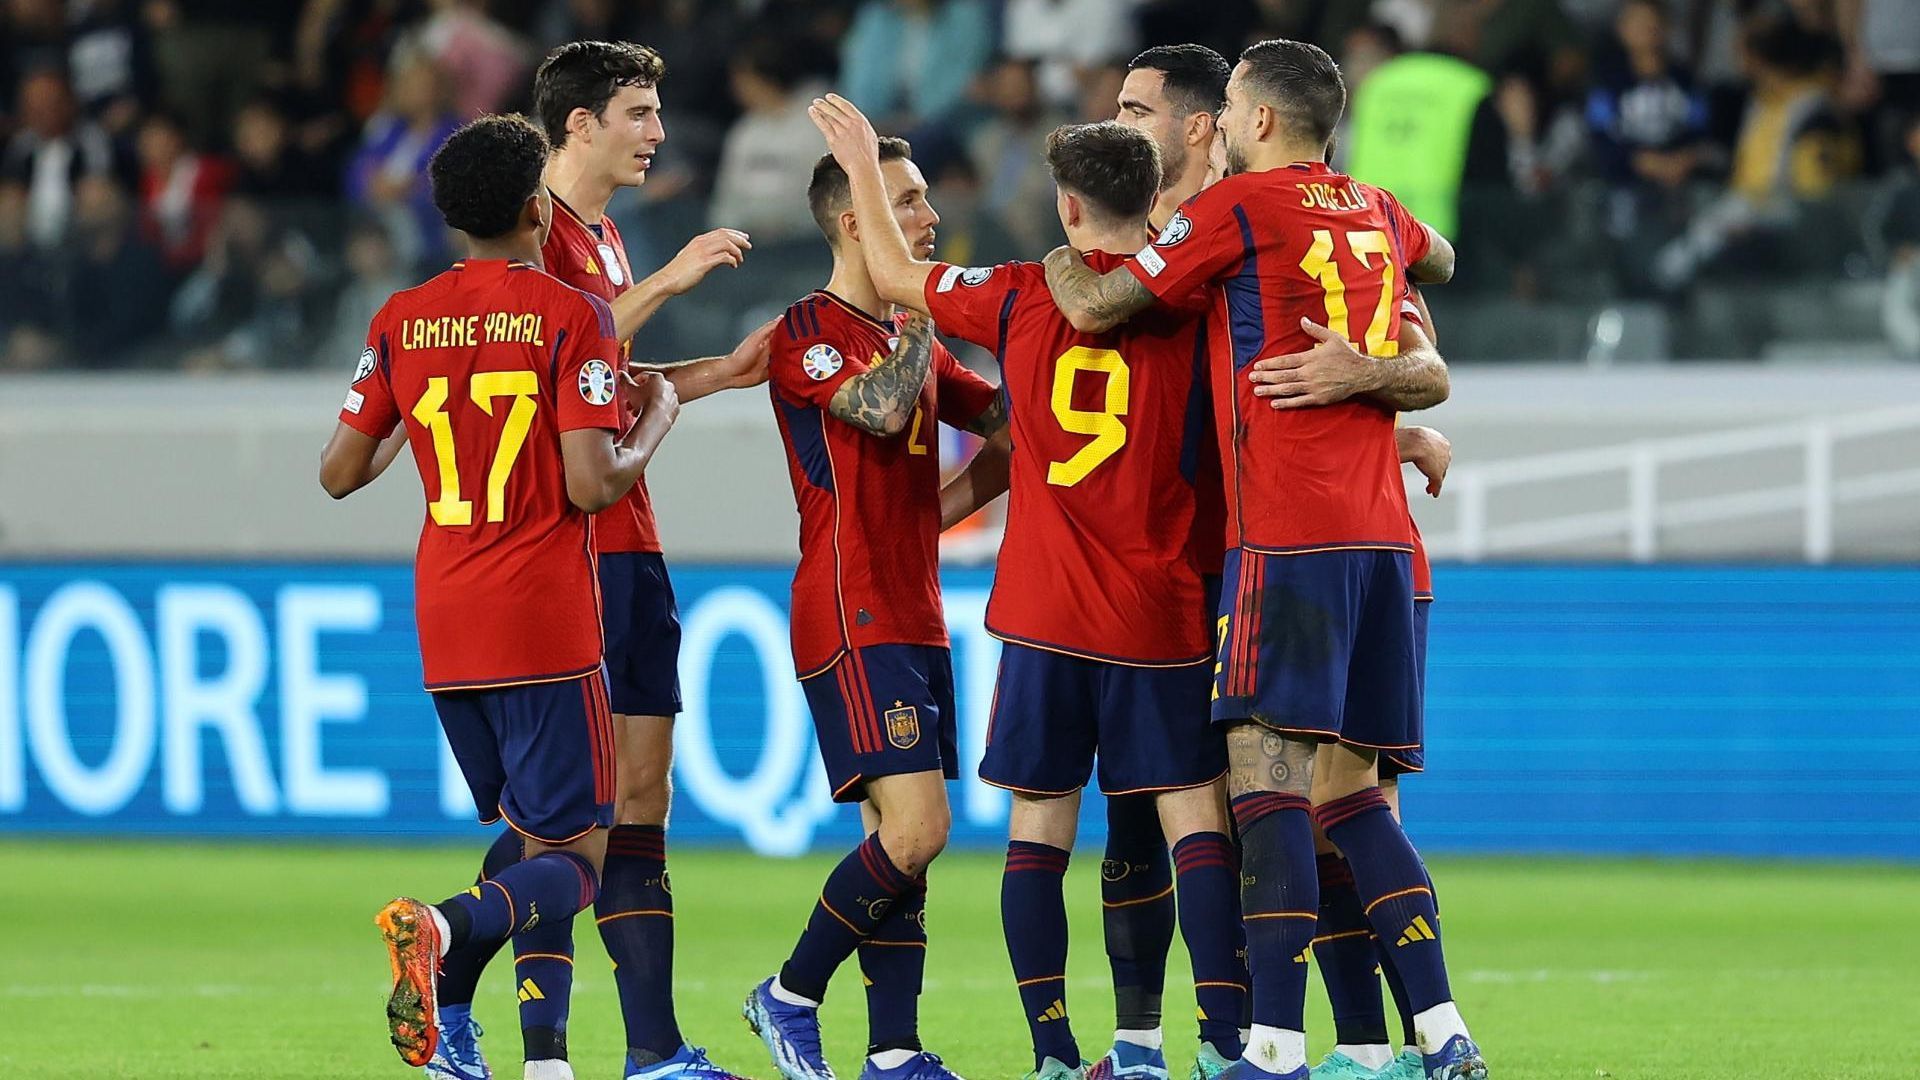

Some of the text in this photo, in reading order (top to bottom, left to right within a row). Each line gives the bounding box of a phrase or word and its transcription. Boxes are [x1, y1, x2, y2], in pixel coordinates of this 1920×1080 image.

[1295, 182, 1368, 211] JOSELU
[402, 312, 544, 350] LAMINE YAMAL
[1298, 229, 1399, 358] 17
[410, 370, 539, 526] 17
[1046, 345, 1130, 487] 9
